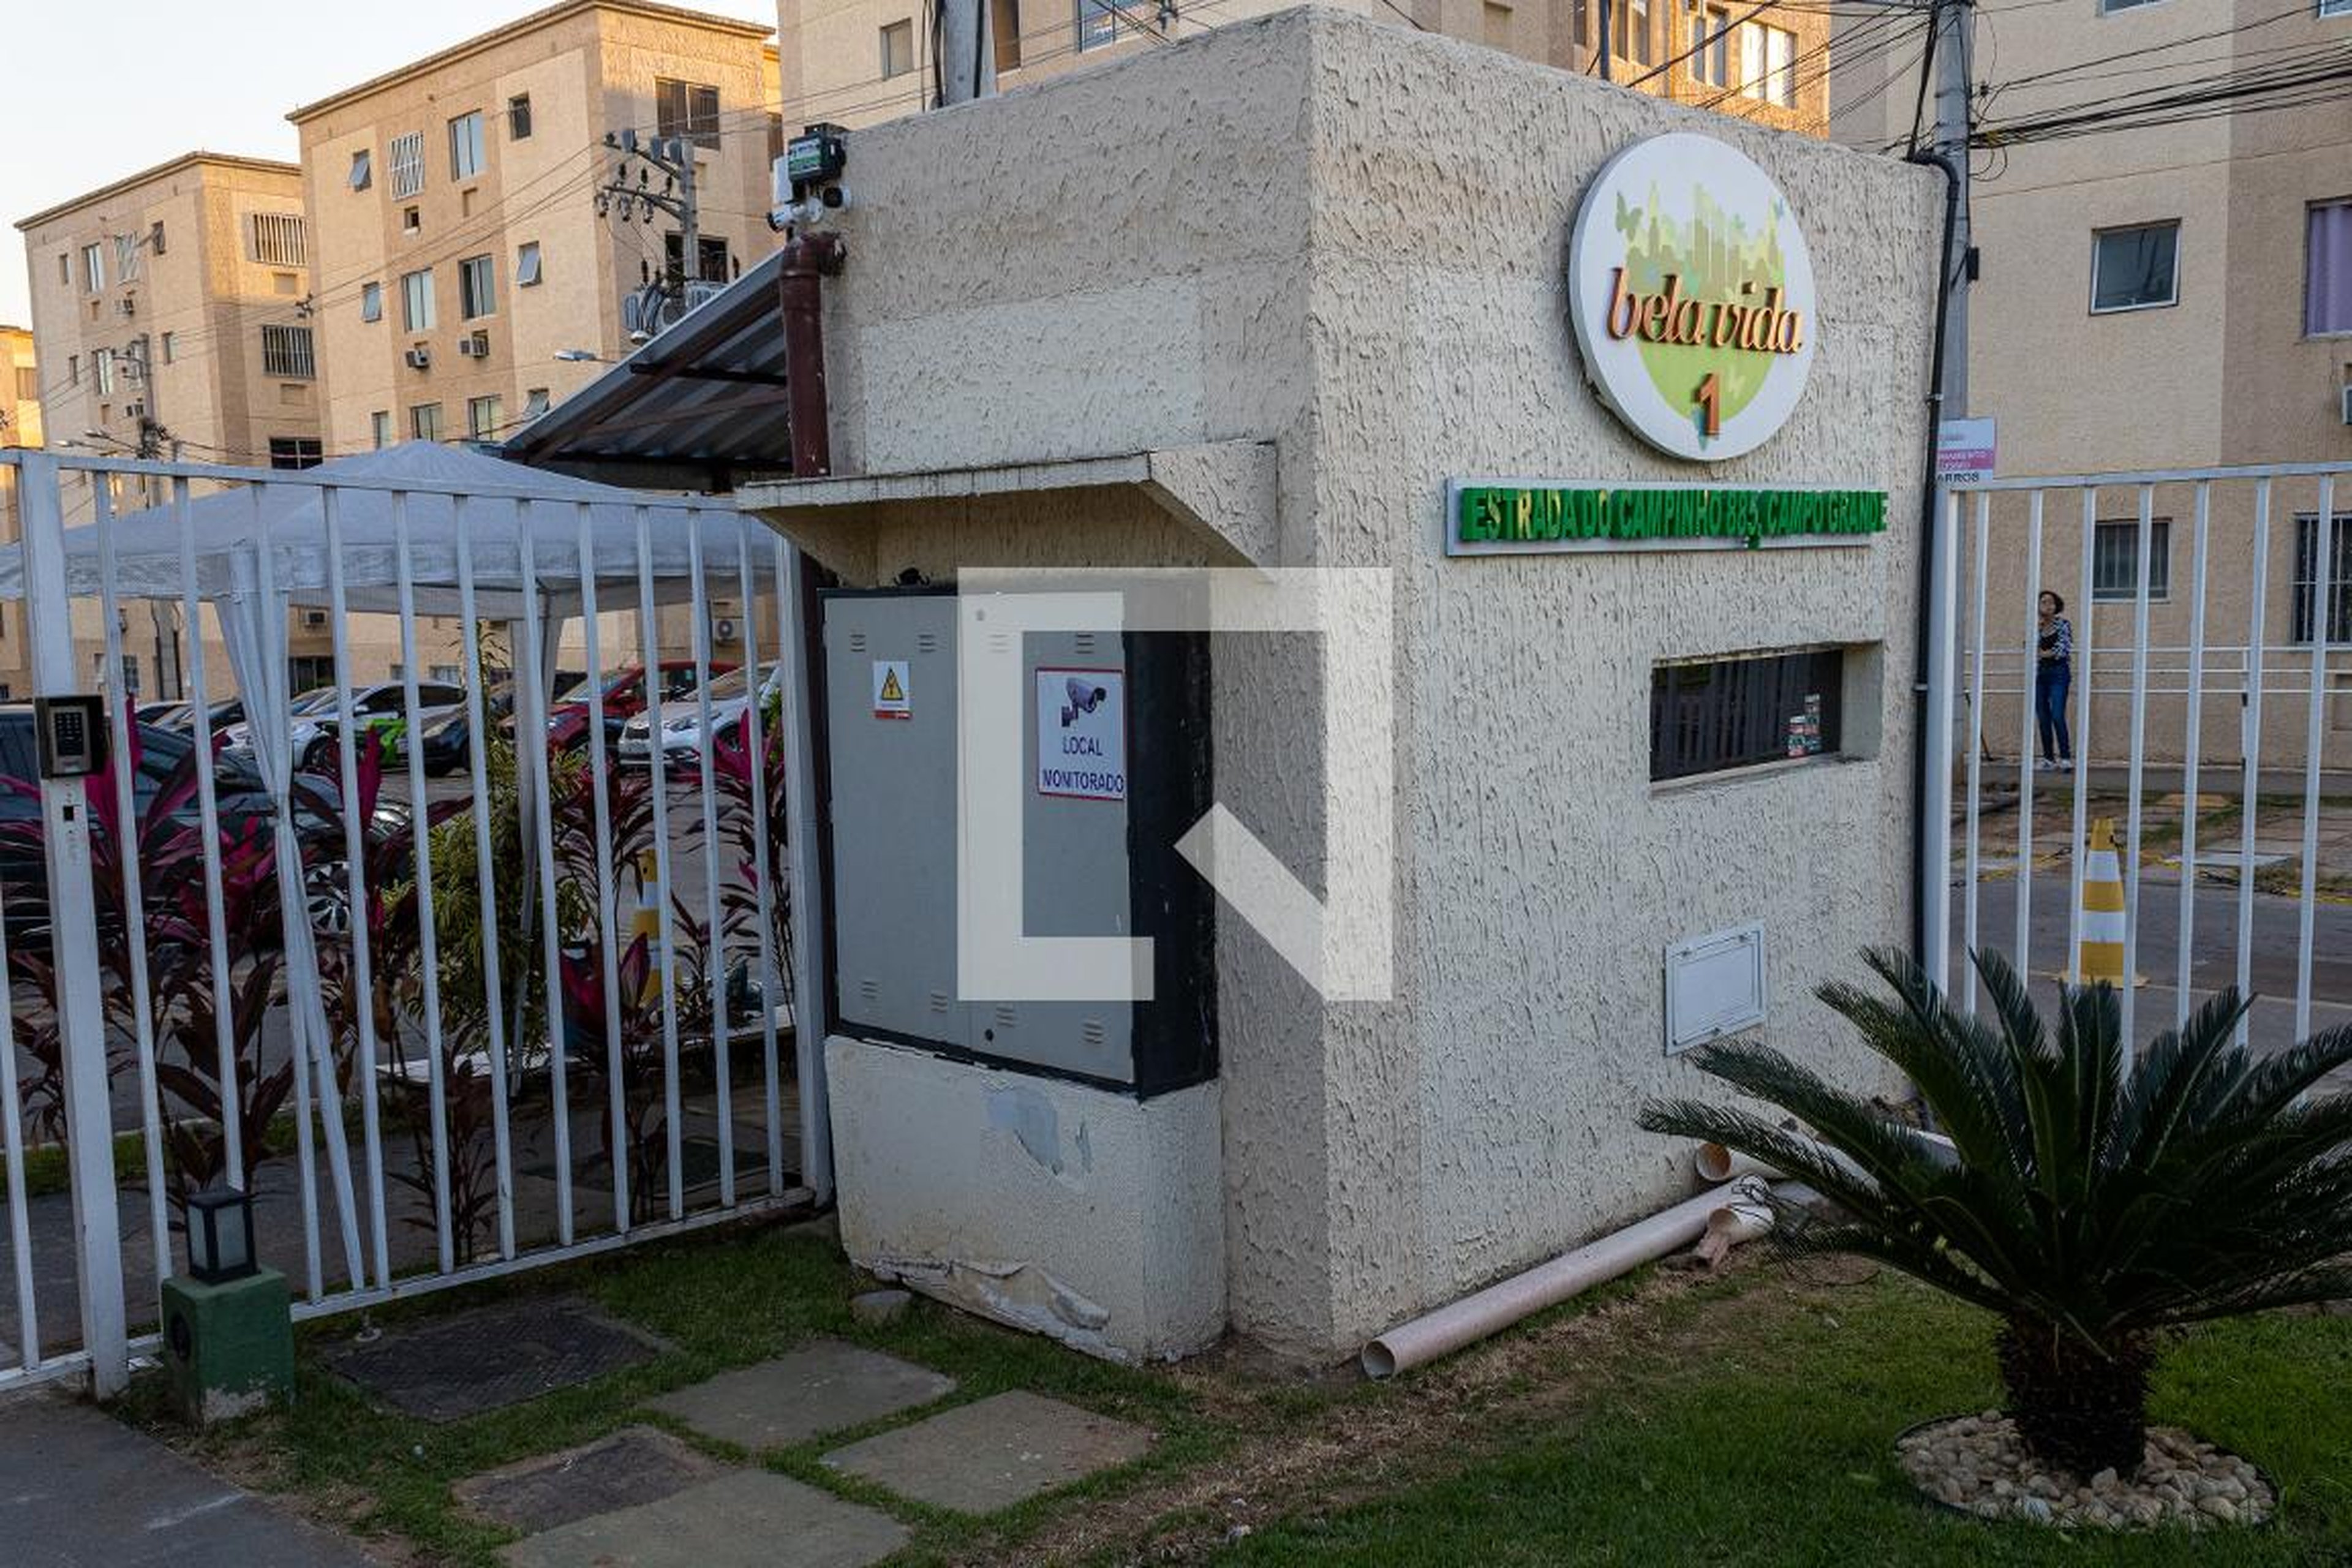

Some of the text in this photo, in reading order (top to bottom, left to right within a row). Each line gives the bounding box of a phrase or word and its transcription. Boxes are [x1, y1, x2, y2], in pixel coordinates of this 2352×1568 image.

[1608, 268, 1802, 353] bela vida
[1692, 372, 1720, 435] 1
[1462, 488, 1577, 541] ESTRADA
[1581, 488, 1612, 540] DO
[1618, 488, 1723, 539] CAMPINHO
[1767, 490, 1825, 537] CAMPO
[1828, 490, 1888, 534] GRANDE
[1063, 736, 1102, 756] LOCAL
